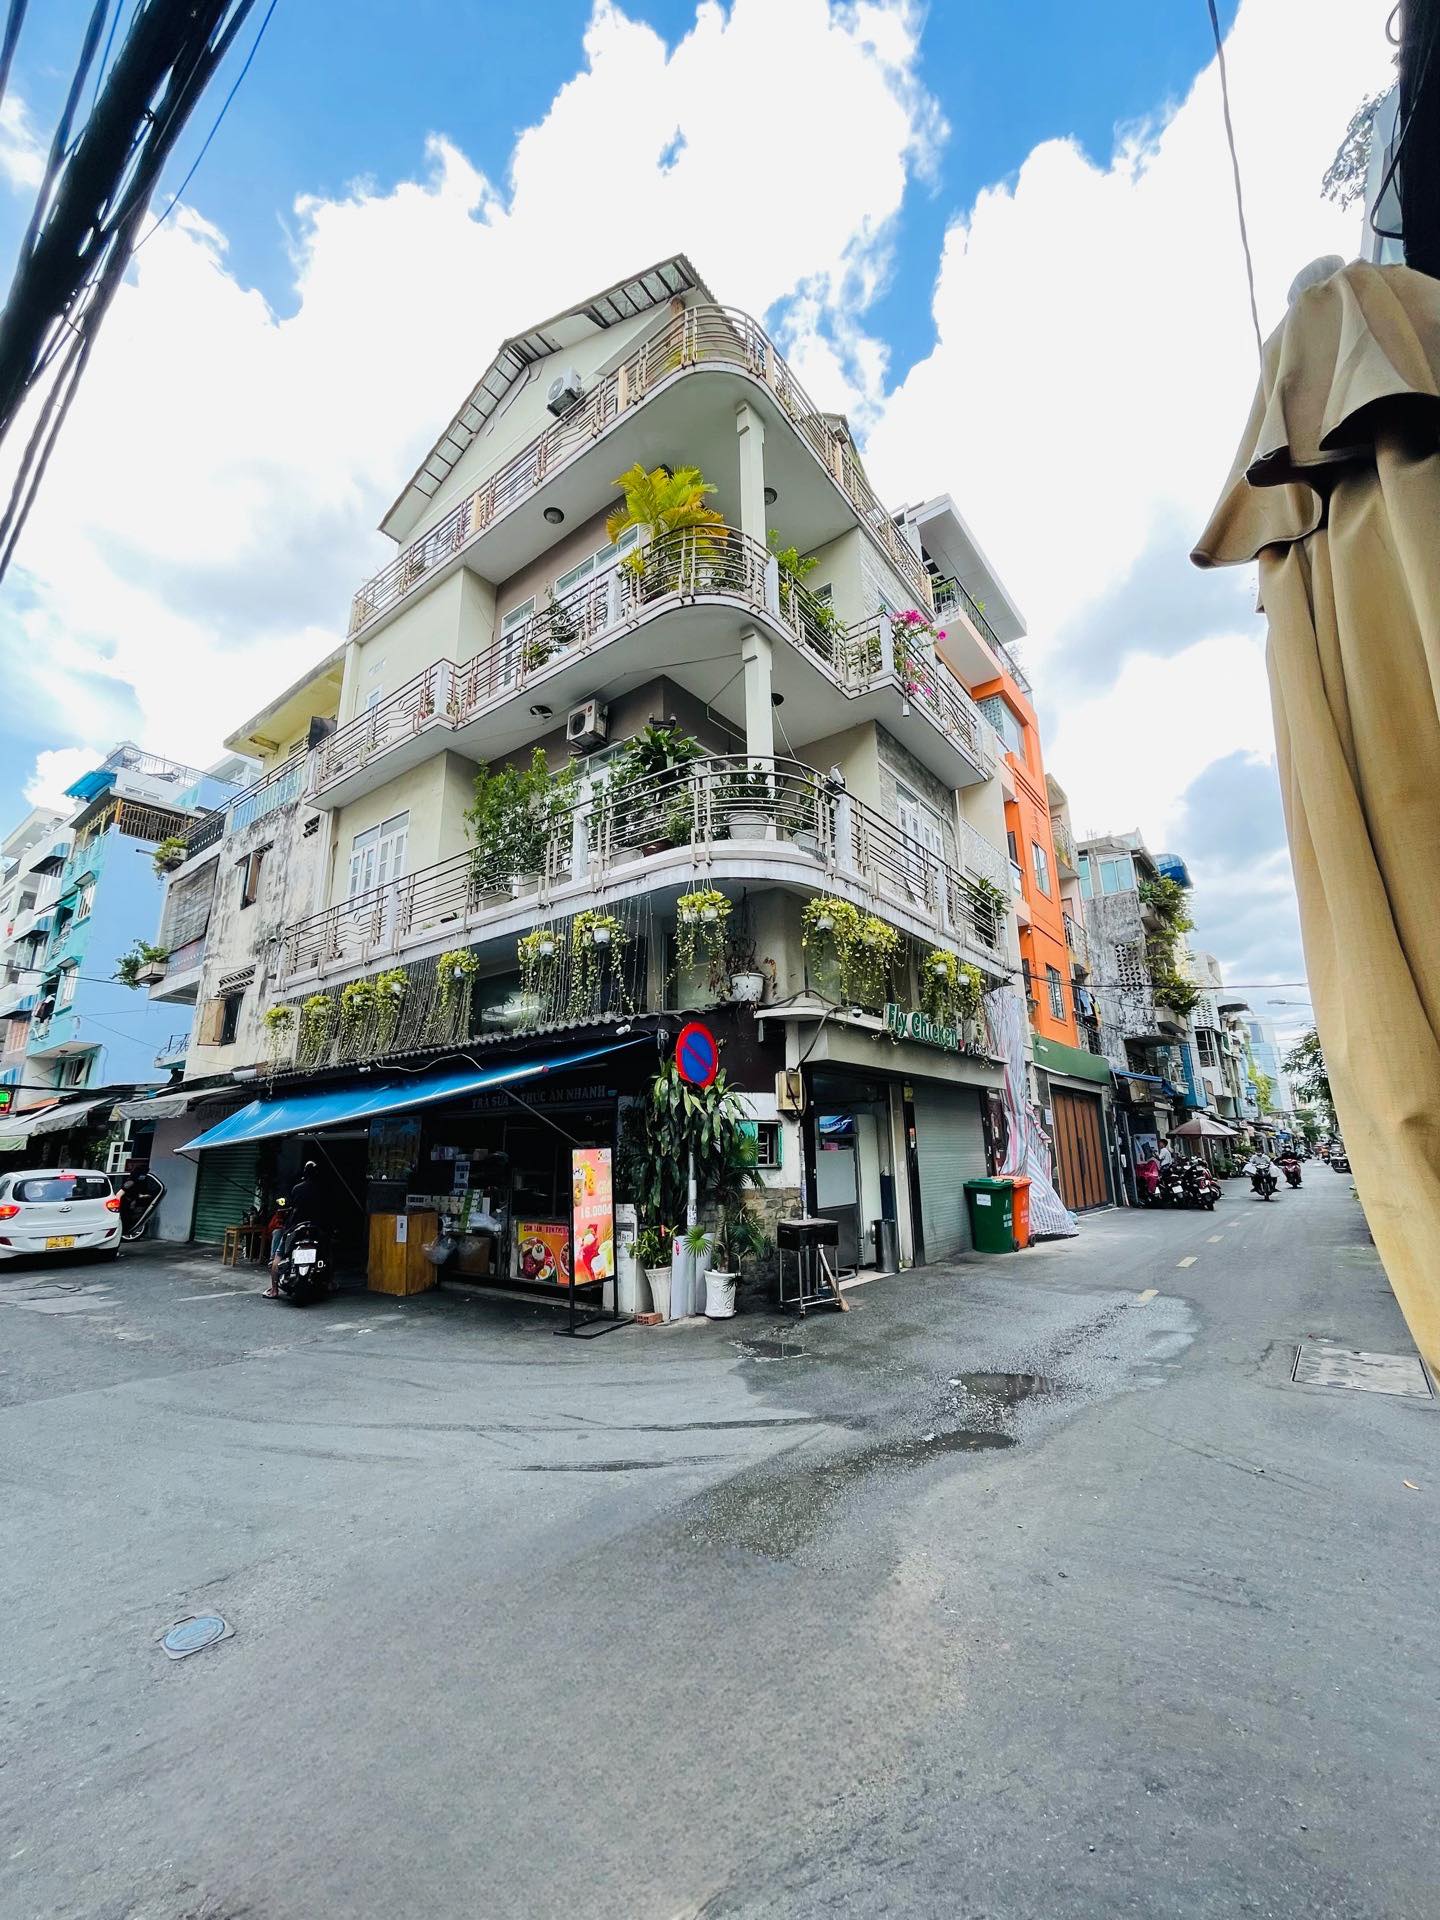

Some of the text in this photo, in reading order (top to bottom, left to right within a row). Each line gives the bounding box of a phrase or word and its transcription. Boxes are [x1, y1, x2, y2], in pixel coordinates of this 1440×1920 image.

[885, 1004, 958, 1049] Fly Chicken
[567, 1084, 607, 1101] NHANH
